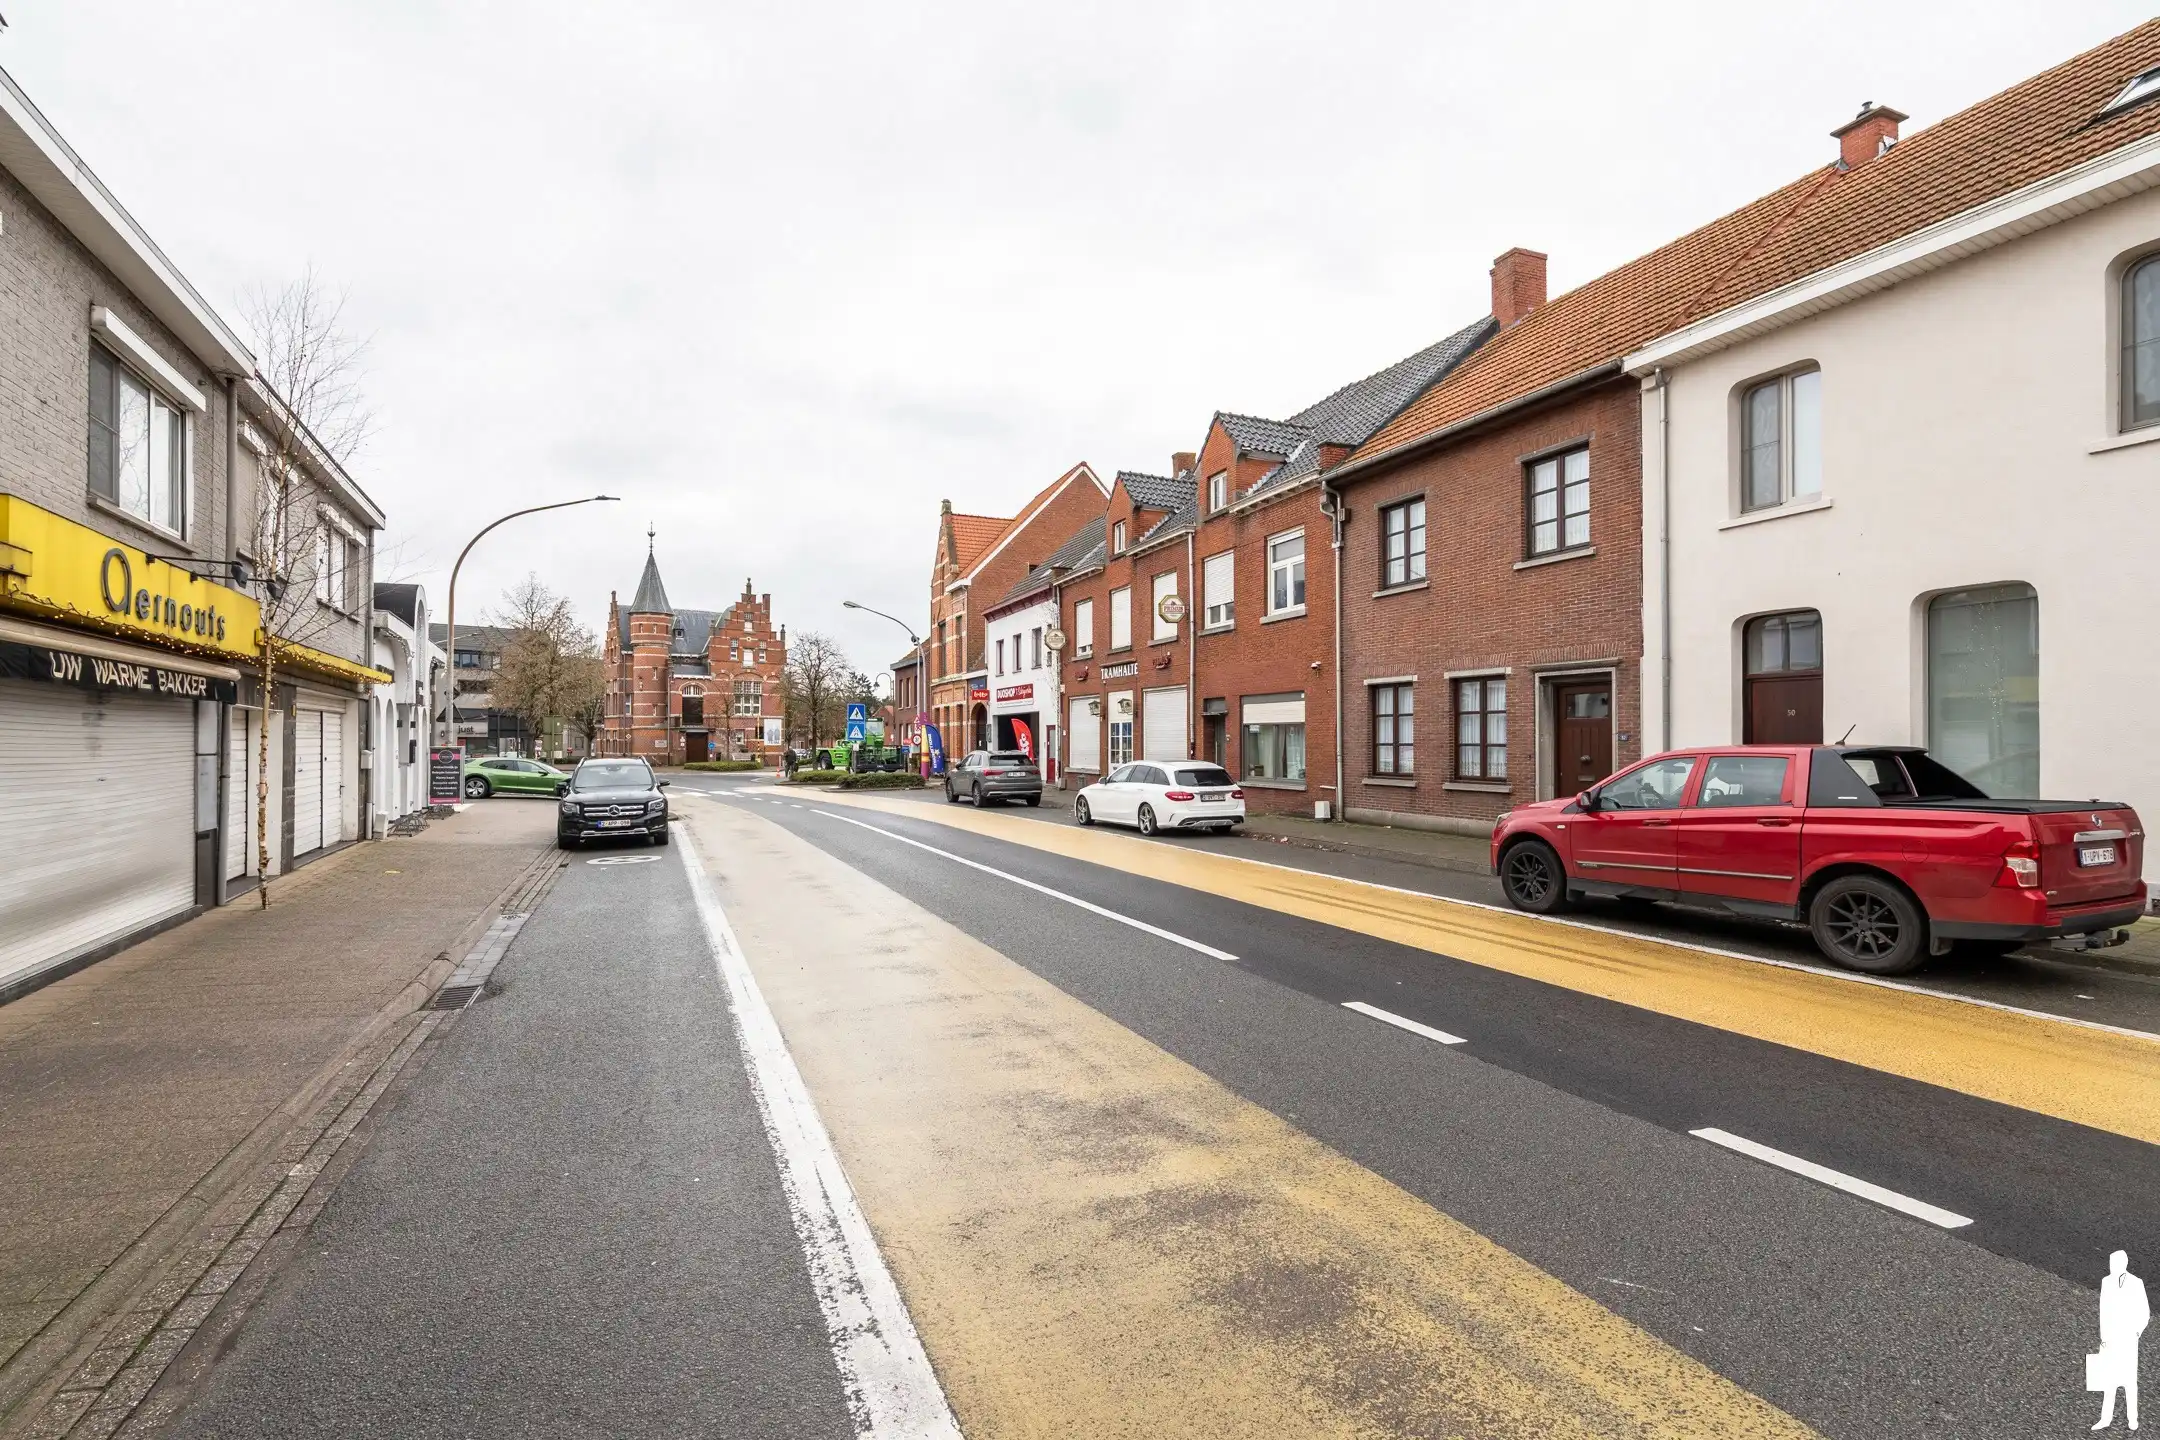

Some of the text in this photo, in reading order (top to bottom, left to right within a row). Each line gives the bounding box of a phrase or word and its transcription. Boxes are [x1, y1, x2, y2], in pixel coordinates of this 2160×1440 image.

[50, 651, 207, 696] UW WARME BAKKER
[1101, 663, 1139, 680] TRAMHALTE
[458, 725, 474, 734] just
